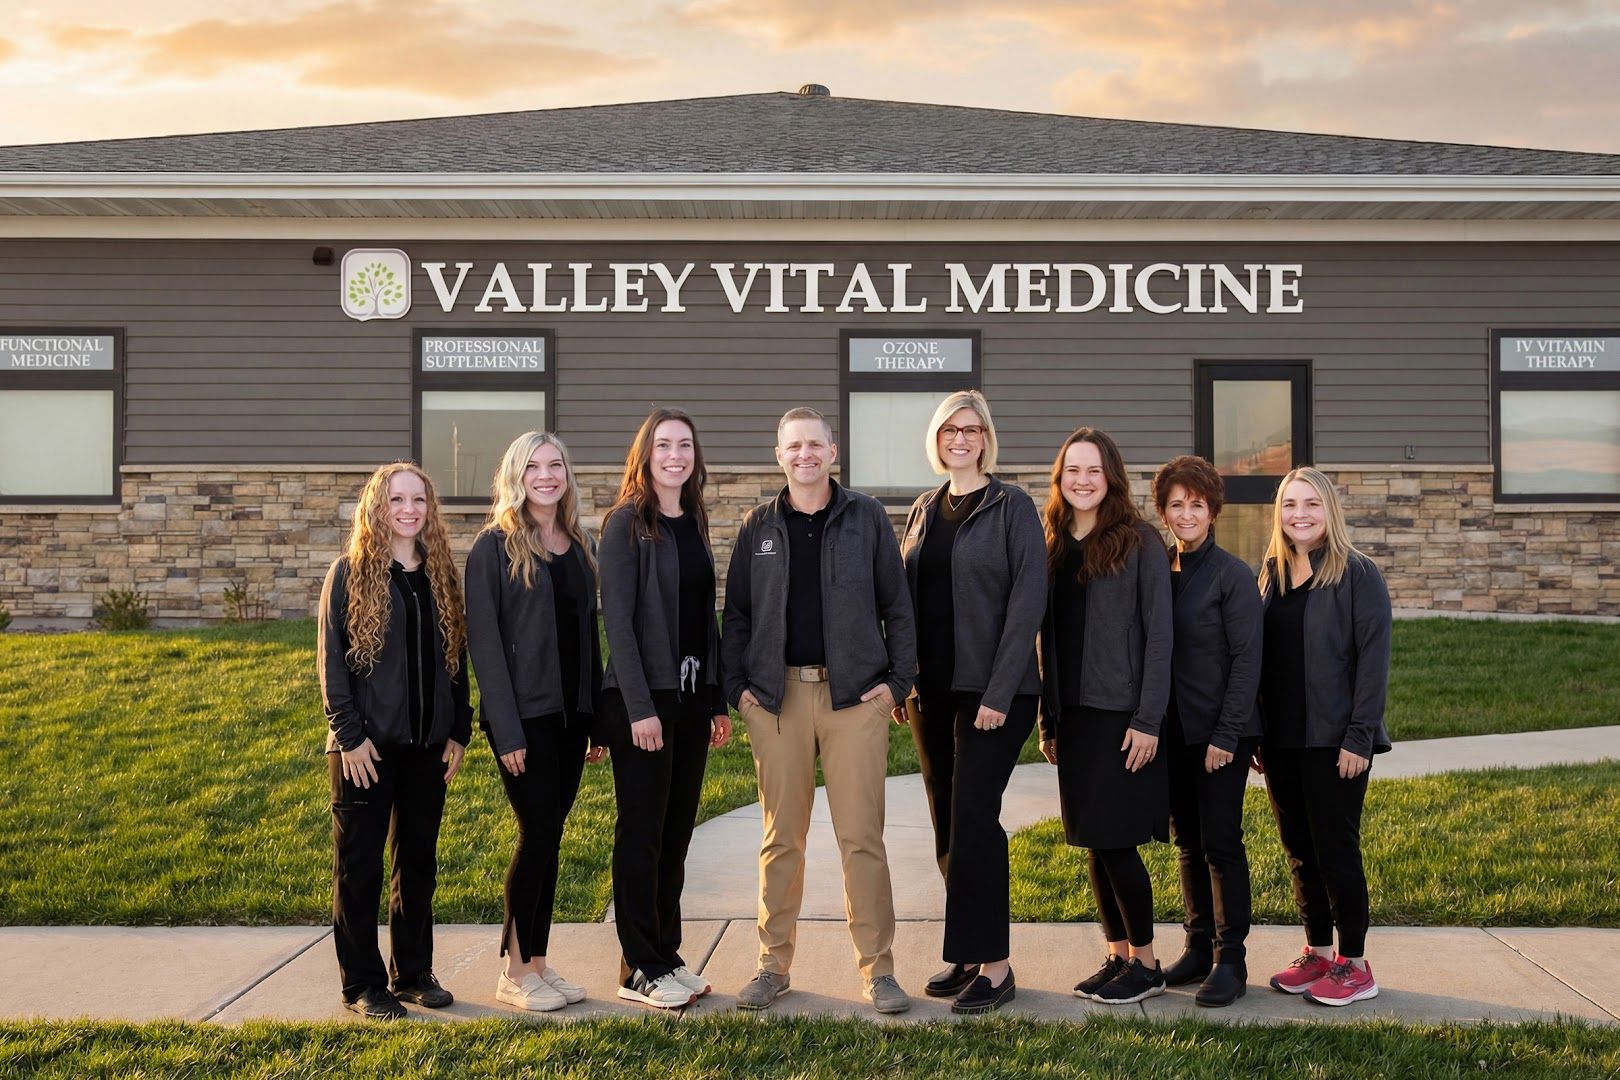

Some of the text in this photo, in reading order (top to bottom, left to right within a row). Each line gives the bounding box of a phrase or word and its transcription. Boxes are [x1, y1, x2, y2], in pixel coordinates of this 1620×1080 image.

[421, 262, 1305, 315] VALLEY VITAL MEDICINE
[0, 338, 104, 352] FUNCTIONAL
[425, 340, 542, 353] PROFESSIONAL
[882, 341, 939, 354] OZONE
[1516, 340, 1606, 353] IV VITAMIN
[11, 353, 92, 368] MEDICINE
[425, 355, 539, 369] SUPPLEMENTS
[874, 356, 946, 370] THERAPY
[1525, 355, 1597, 368] THERAPY
